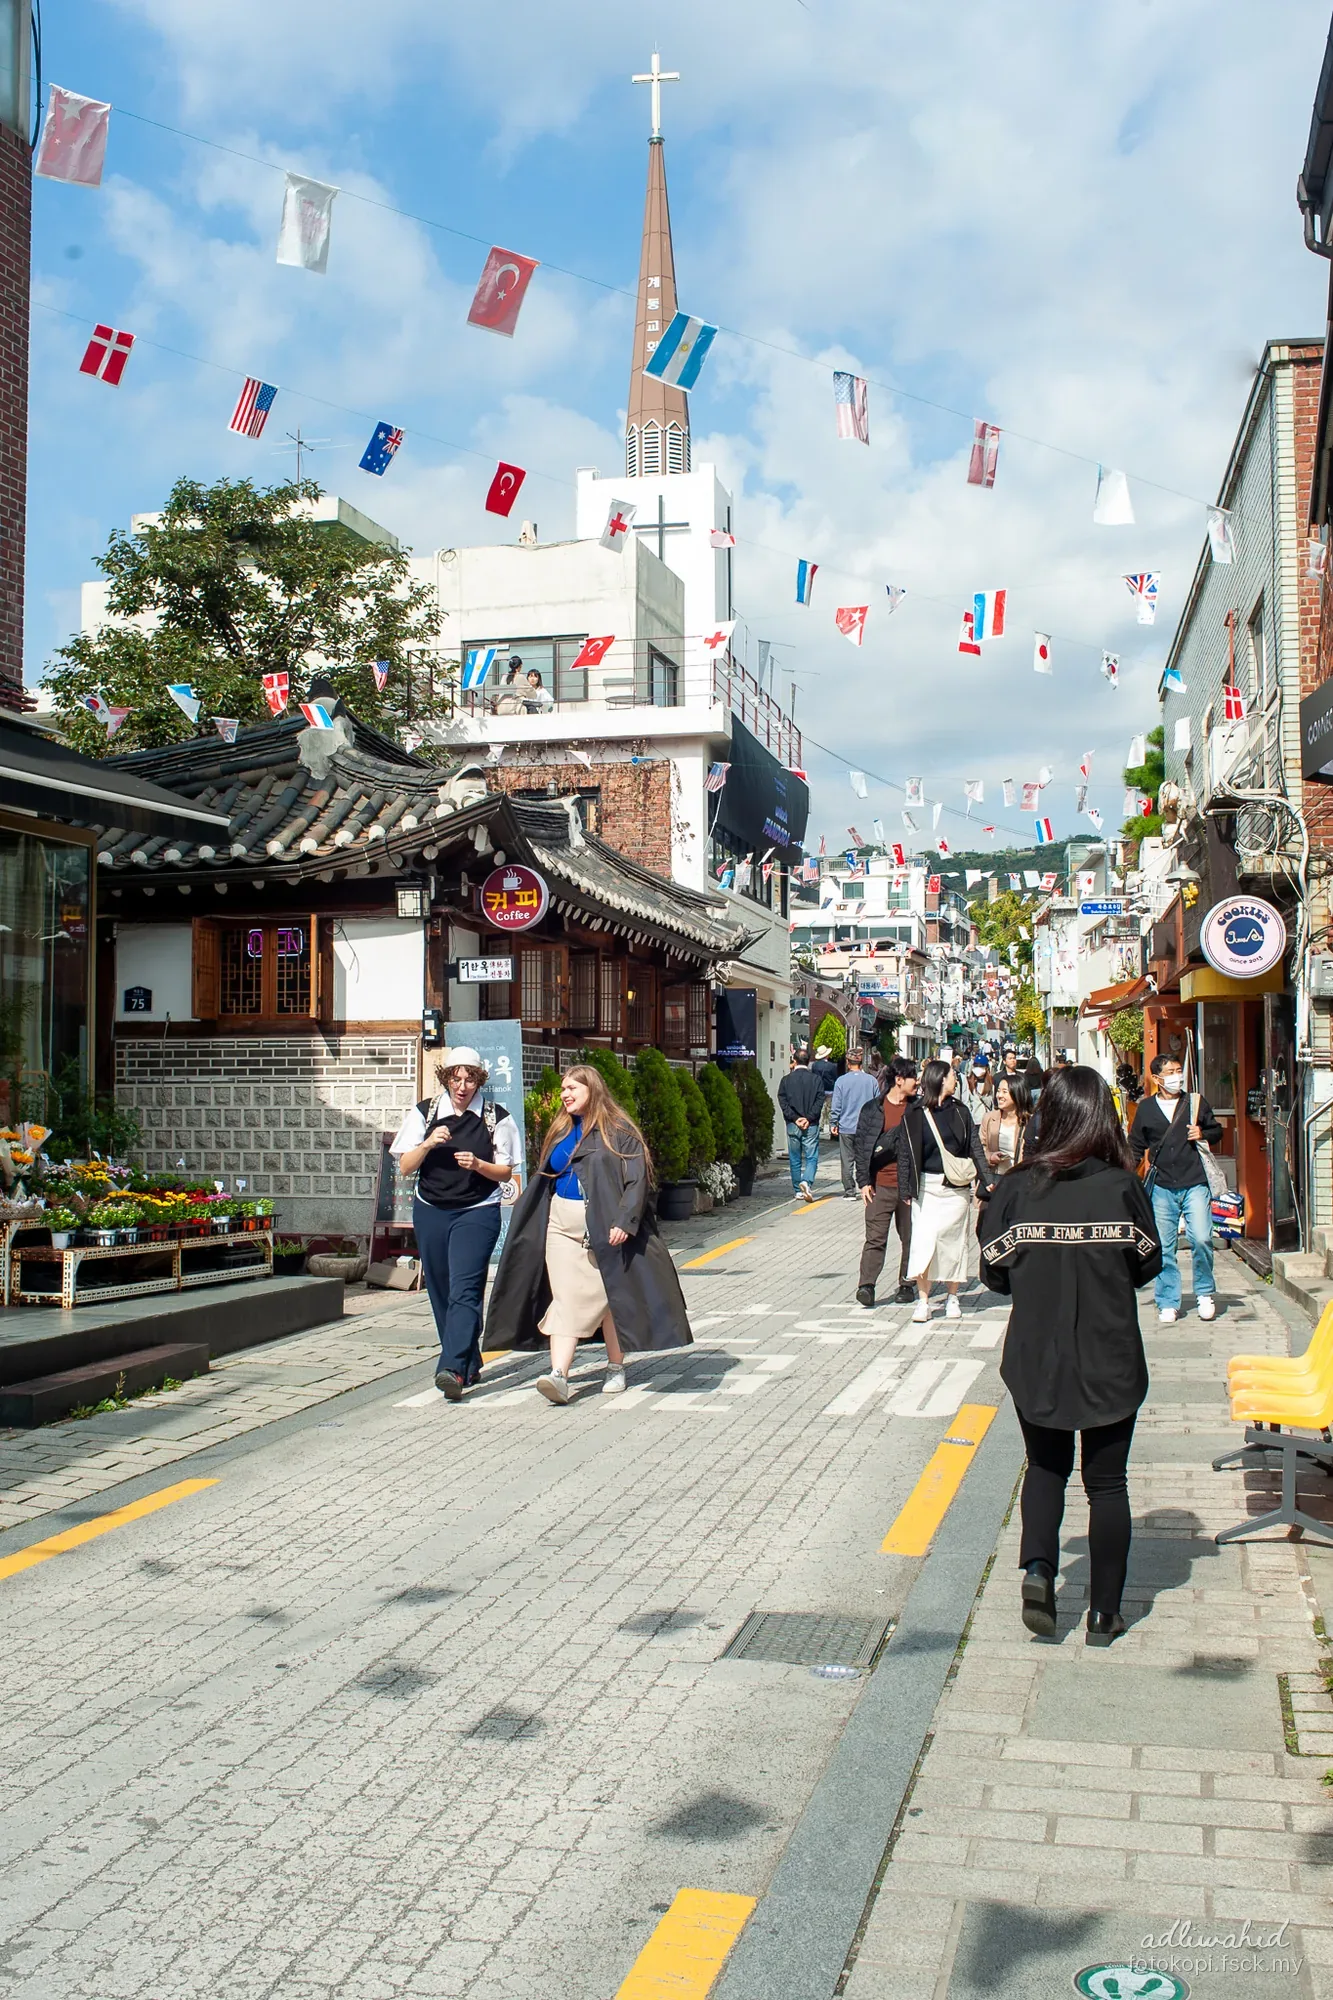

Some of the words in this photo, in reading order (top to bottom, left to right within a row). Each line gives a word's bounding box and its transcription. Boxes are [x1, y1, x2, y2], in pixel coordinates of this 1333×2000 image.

[485, 888, 538, 911] 커피
[496, 910, 531, 921] Coffee
[1217, 905, 1271, 926] COOKIES
[131, 998, 145, 1010] 75
[488, 1085, 512, 1093] Hanok
